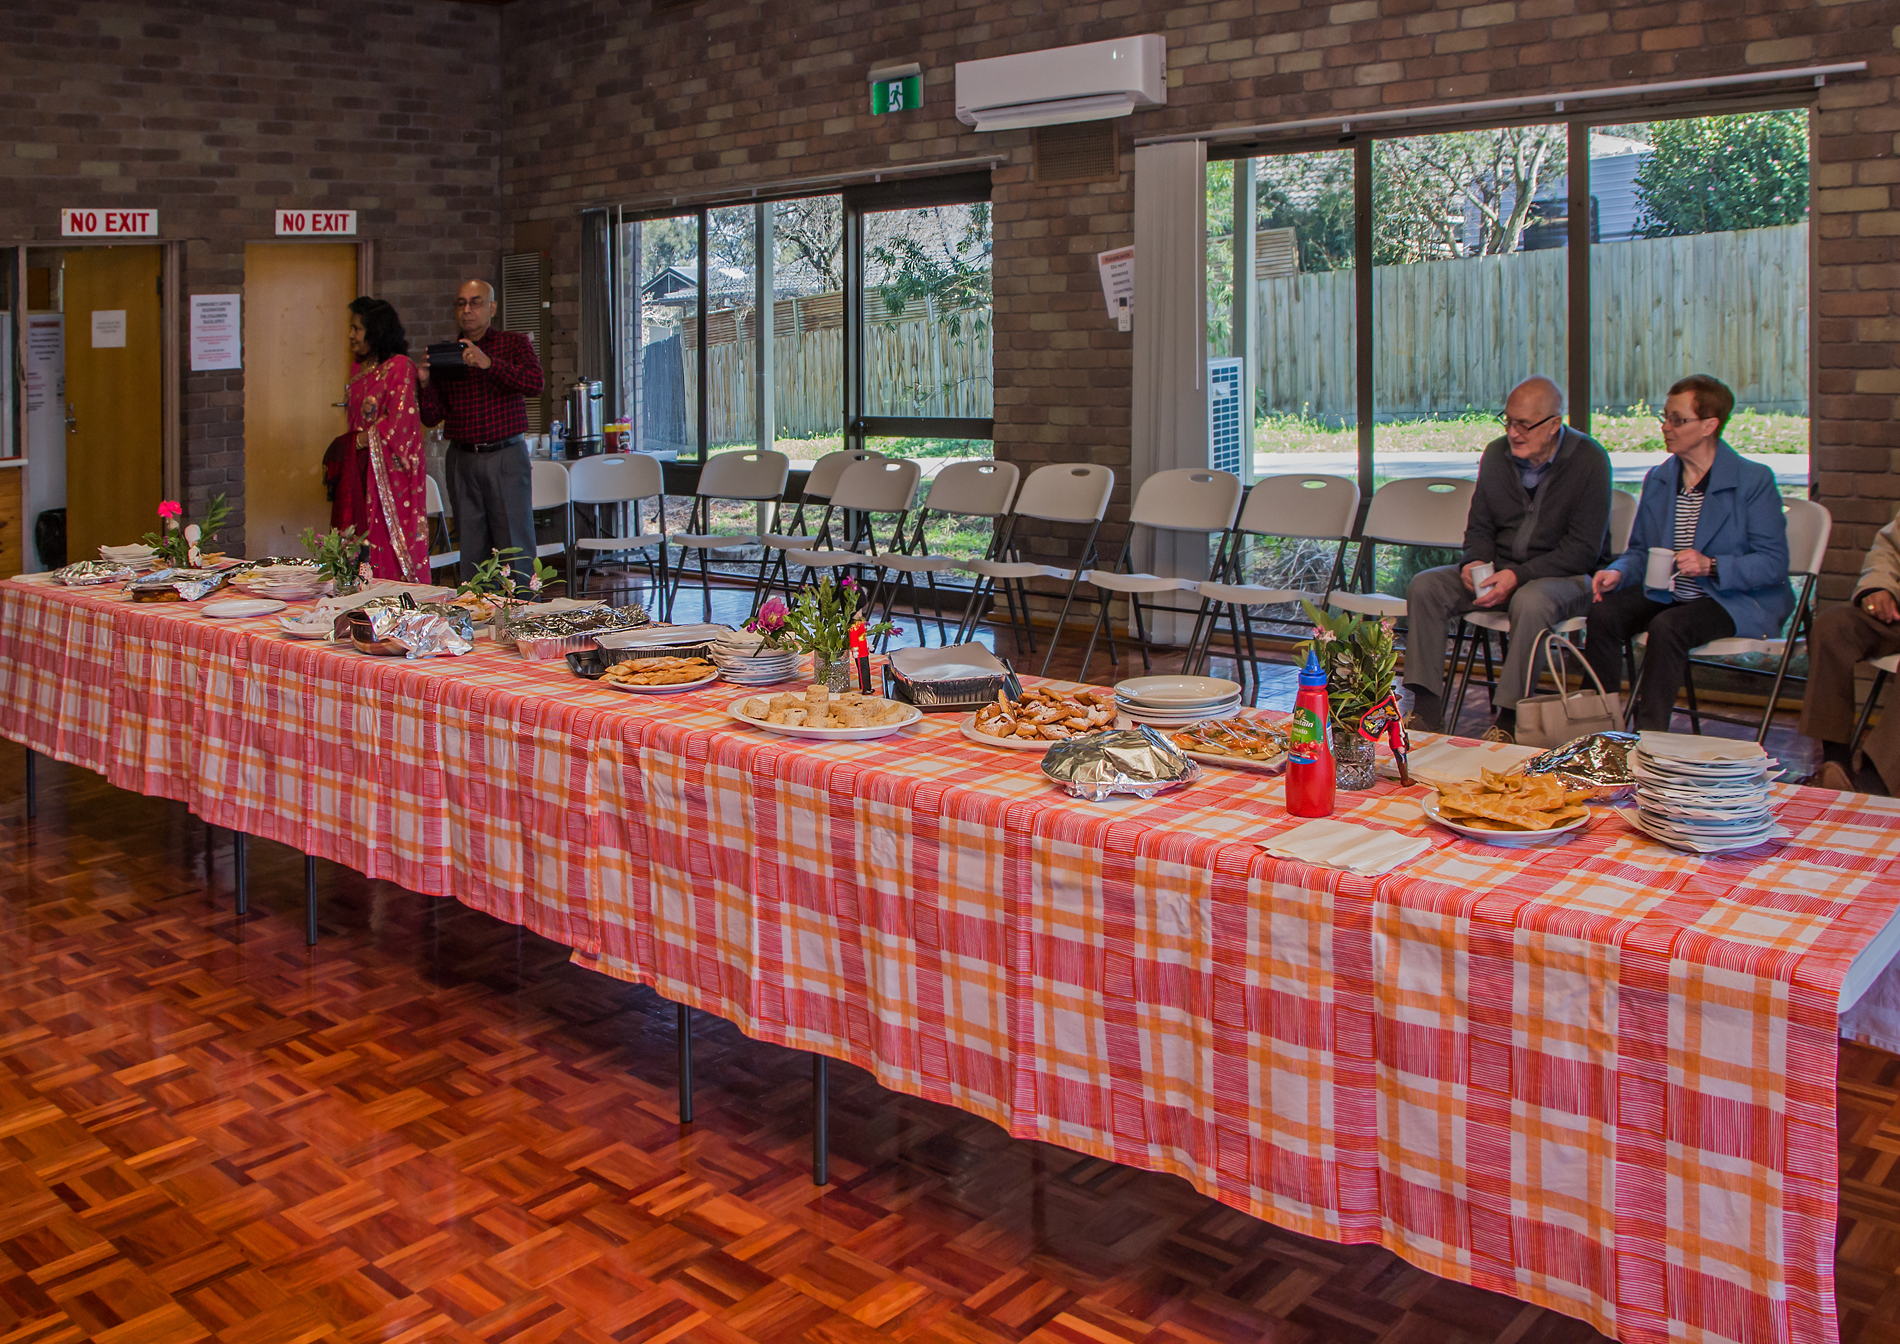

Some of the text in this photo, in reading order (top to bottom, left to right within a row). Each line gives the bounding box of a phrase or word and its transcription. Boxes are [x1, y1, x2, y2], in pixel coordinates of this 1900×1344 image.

[70, 212, 150, 232] NO EXIT
[282, 213, 350, 232] NO EXIT
[1111, 270, 1129, 278] REMOVE
